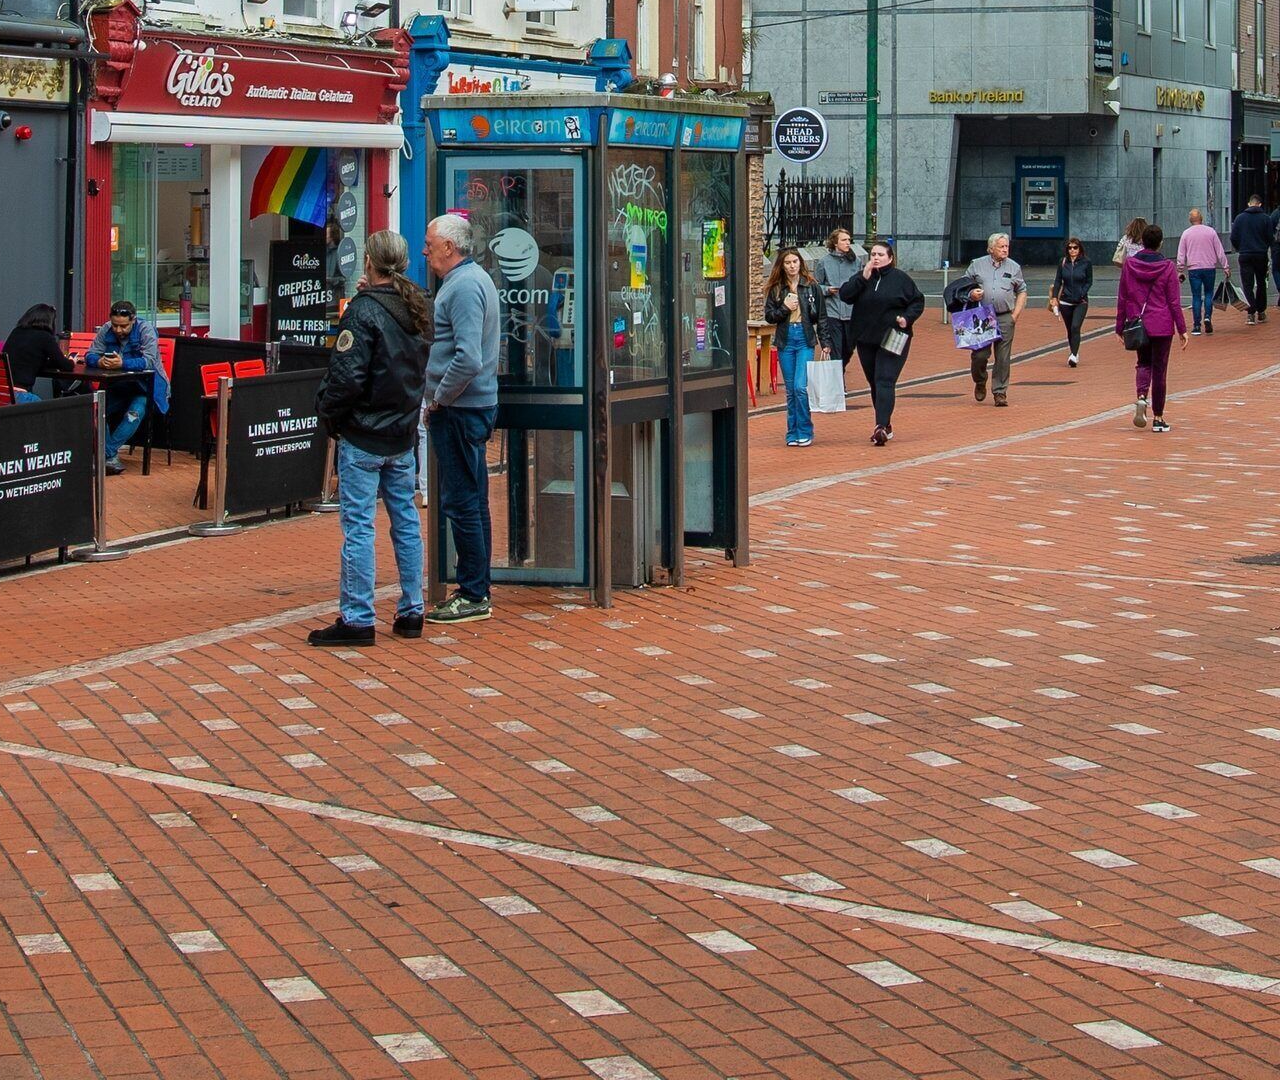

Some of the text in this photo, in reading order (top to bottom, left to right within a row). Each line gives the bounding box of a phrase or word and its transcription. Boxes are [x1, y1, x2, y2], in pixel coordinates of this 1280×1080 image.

[167, 49, 235, 99] Gino's
[181, 94, 221, 107] GELATO
[246, 85, 354, 103] Authentic Italian Gelateria
[928, 90, 1024, 103] Bank of Ireland
[494, 119, 561, 135] eircom
[634, 121, 666, 138] eircom
[786, 128, 813, 136] HEAD
[779, 135, 821, 143] BARBERS
[292, 253, 320, 267] Gino's
[278, 279, 321, 296] CREPES &
[292, 289, 333, 308] WAFFLES
[497, 288, 558, 304] rcom
[277, 319, 331, 331] MADE FRESH
[277, 407, 291, 418] THE
[248, 416, 318, 437] LINEN WEAVER
[23, 442, 39, 454] THE
[255, 440, 311, 457] JD WETHERSPOON
[27, 450, 72, 471] WEAVER
[6, 478, 62, 498] WETHERSPOON
